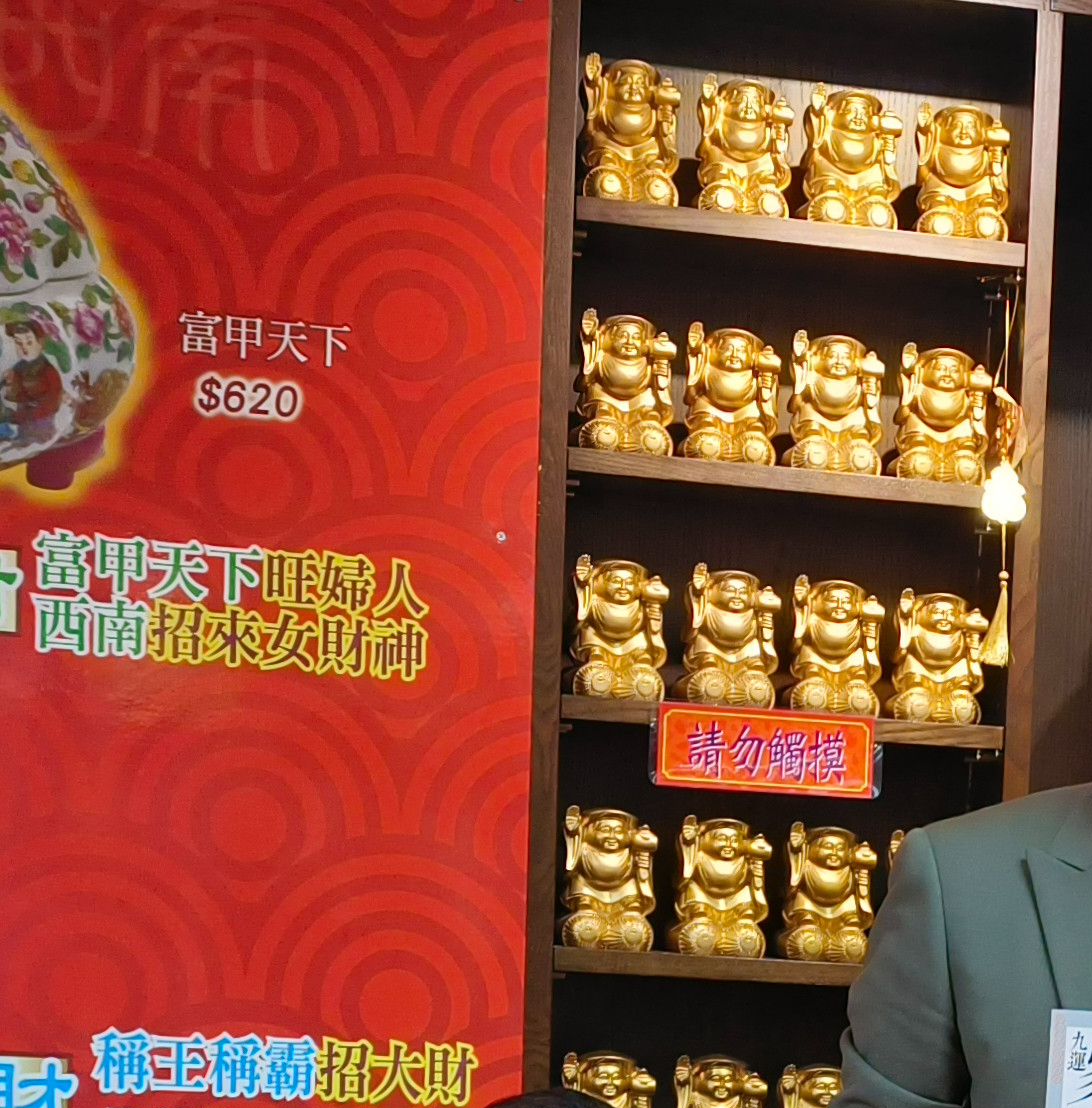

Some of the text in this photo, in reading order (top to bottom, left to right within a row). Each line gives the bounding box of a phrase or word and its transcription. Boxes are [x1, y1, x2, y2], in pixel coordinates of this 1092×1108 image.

[178, 311, 351, 367] 富甲天下
[197, 378, 299, 419] $620
[33, 529, 428, 616] 富甲天下旺婦人
[30, 596, 426, 680] 西南招來女財神
[686, 721, 848, 786] 請勿觸摸
[92, 1027, 478, 1106] 稱王稱霸招大財
[1067, 1032, 1087, 1073] 九運
